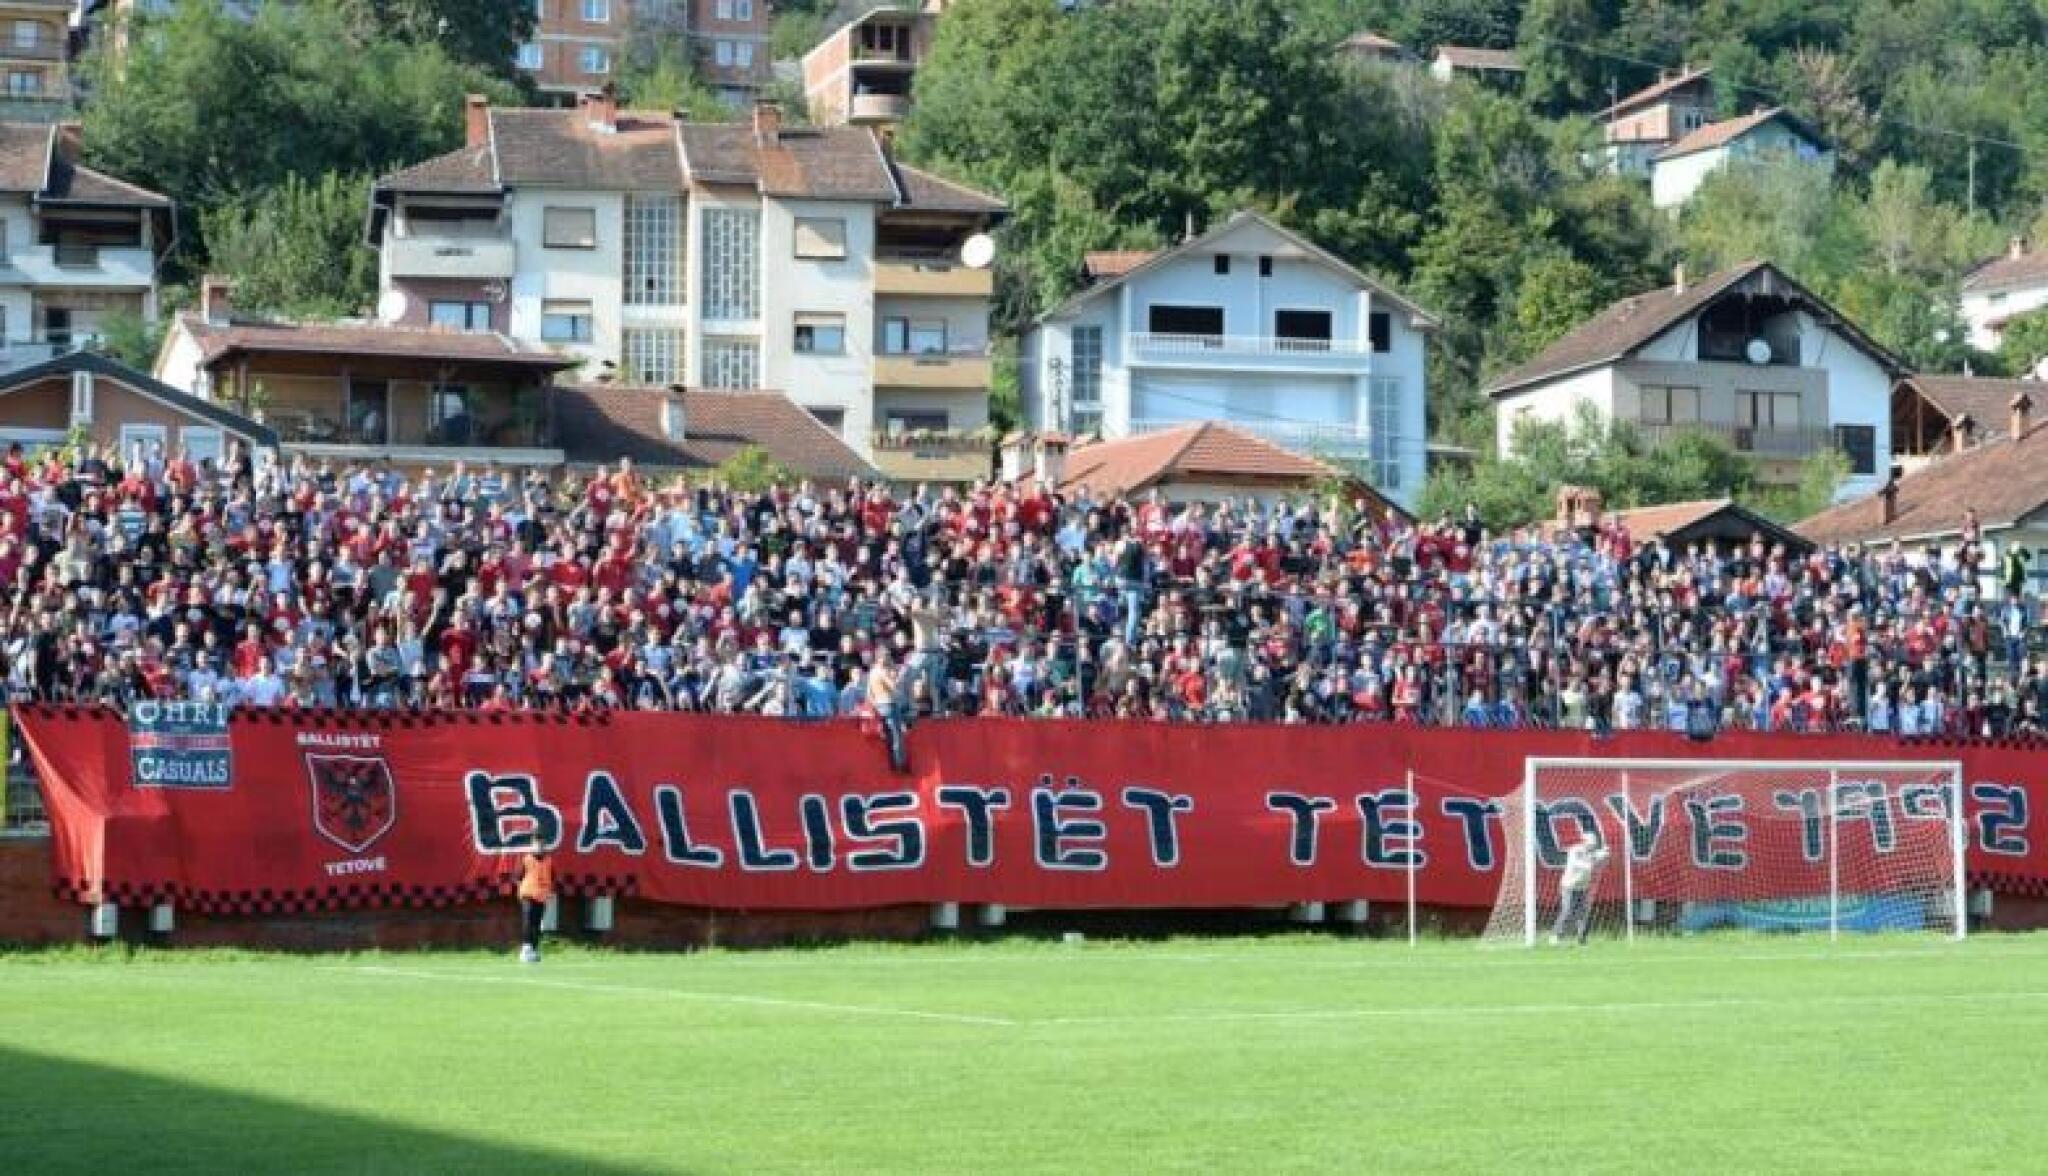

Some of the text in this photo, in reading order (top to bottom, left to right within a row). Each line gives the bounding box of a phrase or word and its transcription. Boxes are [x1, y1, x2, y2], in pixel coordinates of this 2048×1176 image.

[138, 757, 228, 781] CASUALS
[1266, 788, 1748, 871] TETOVE
[1774, 780, 2028, 862] 1992
